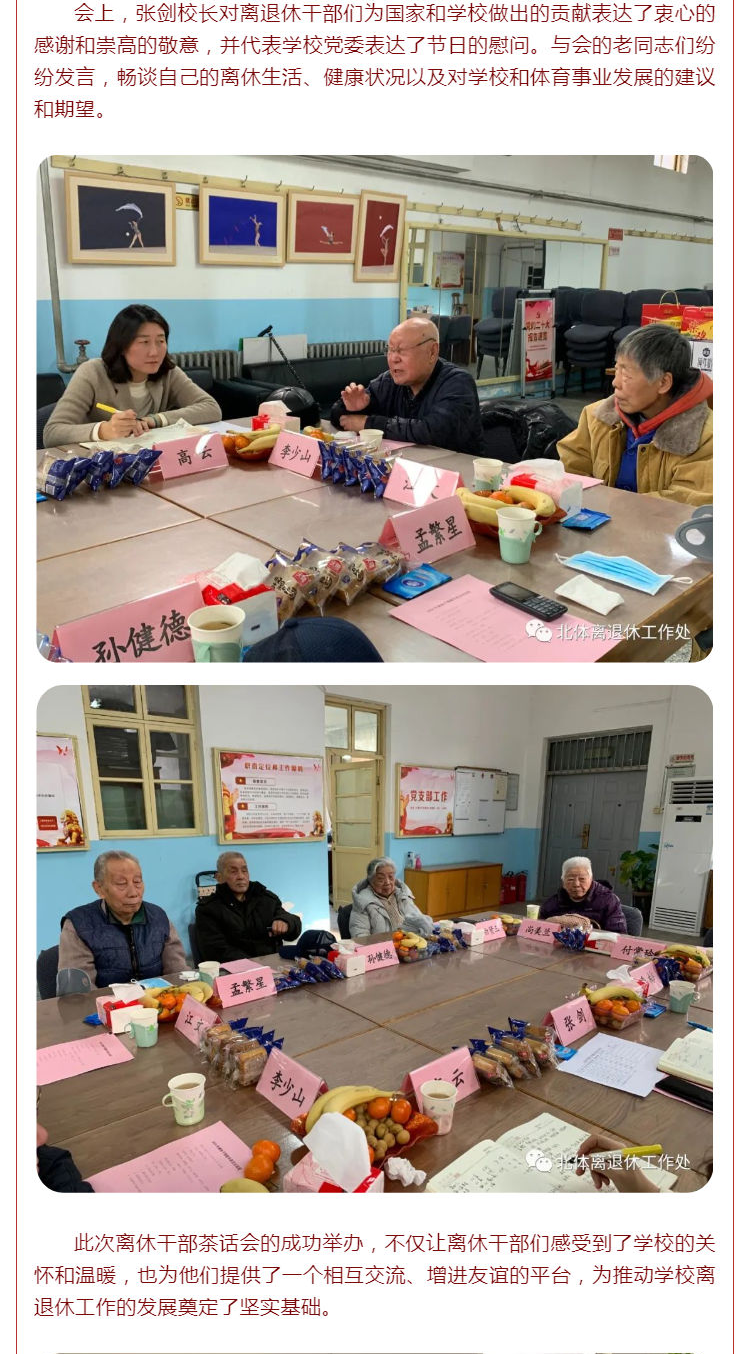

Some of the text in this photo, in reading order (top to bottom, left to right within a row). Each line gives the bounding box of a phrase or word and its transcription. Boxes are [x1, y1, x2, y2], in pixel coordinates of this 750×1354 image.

[176, 446, 213, 466] 高云
[279, 443, 312, 463] 李少山
[415, 516, 462, 554] 孟繁星
[91, 609, 191, 663] 孙健德
[410, 789, 449, 803] 党支部工作
[229, 976, 267, 997] 孟繁星
[563, 1007, 588, 1032] 张剑
[269, 1070, 306, 1107] 李少山
